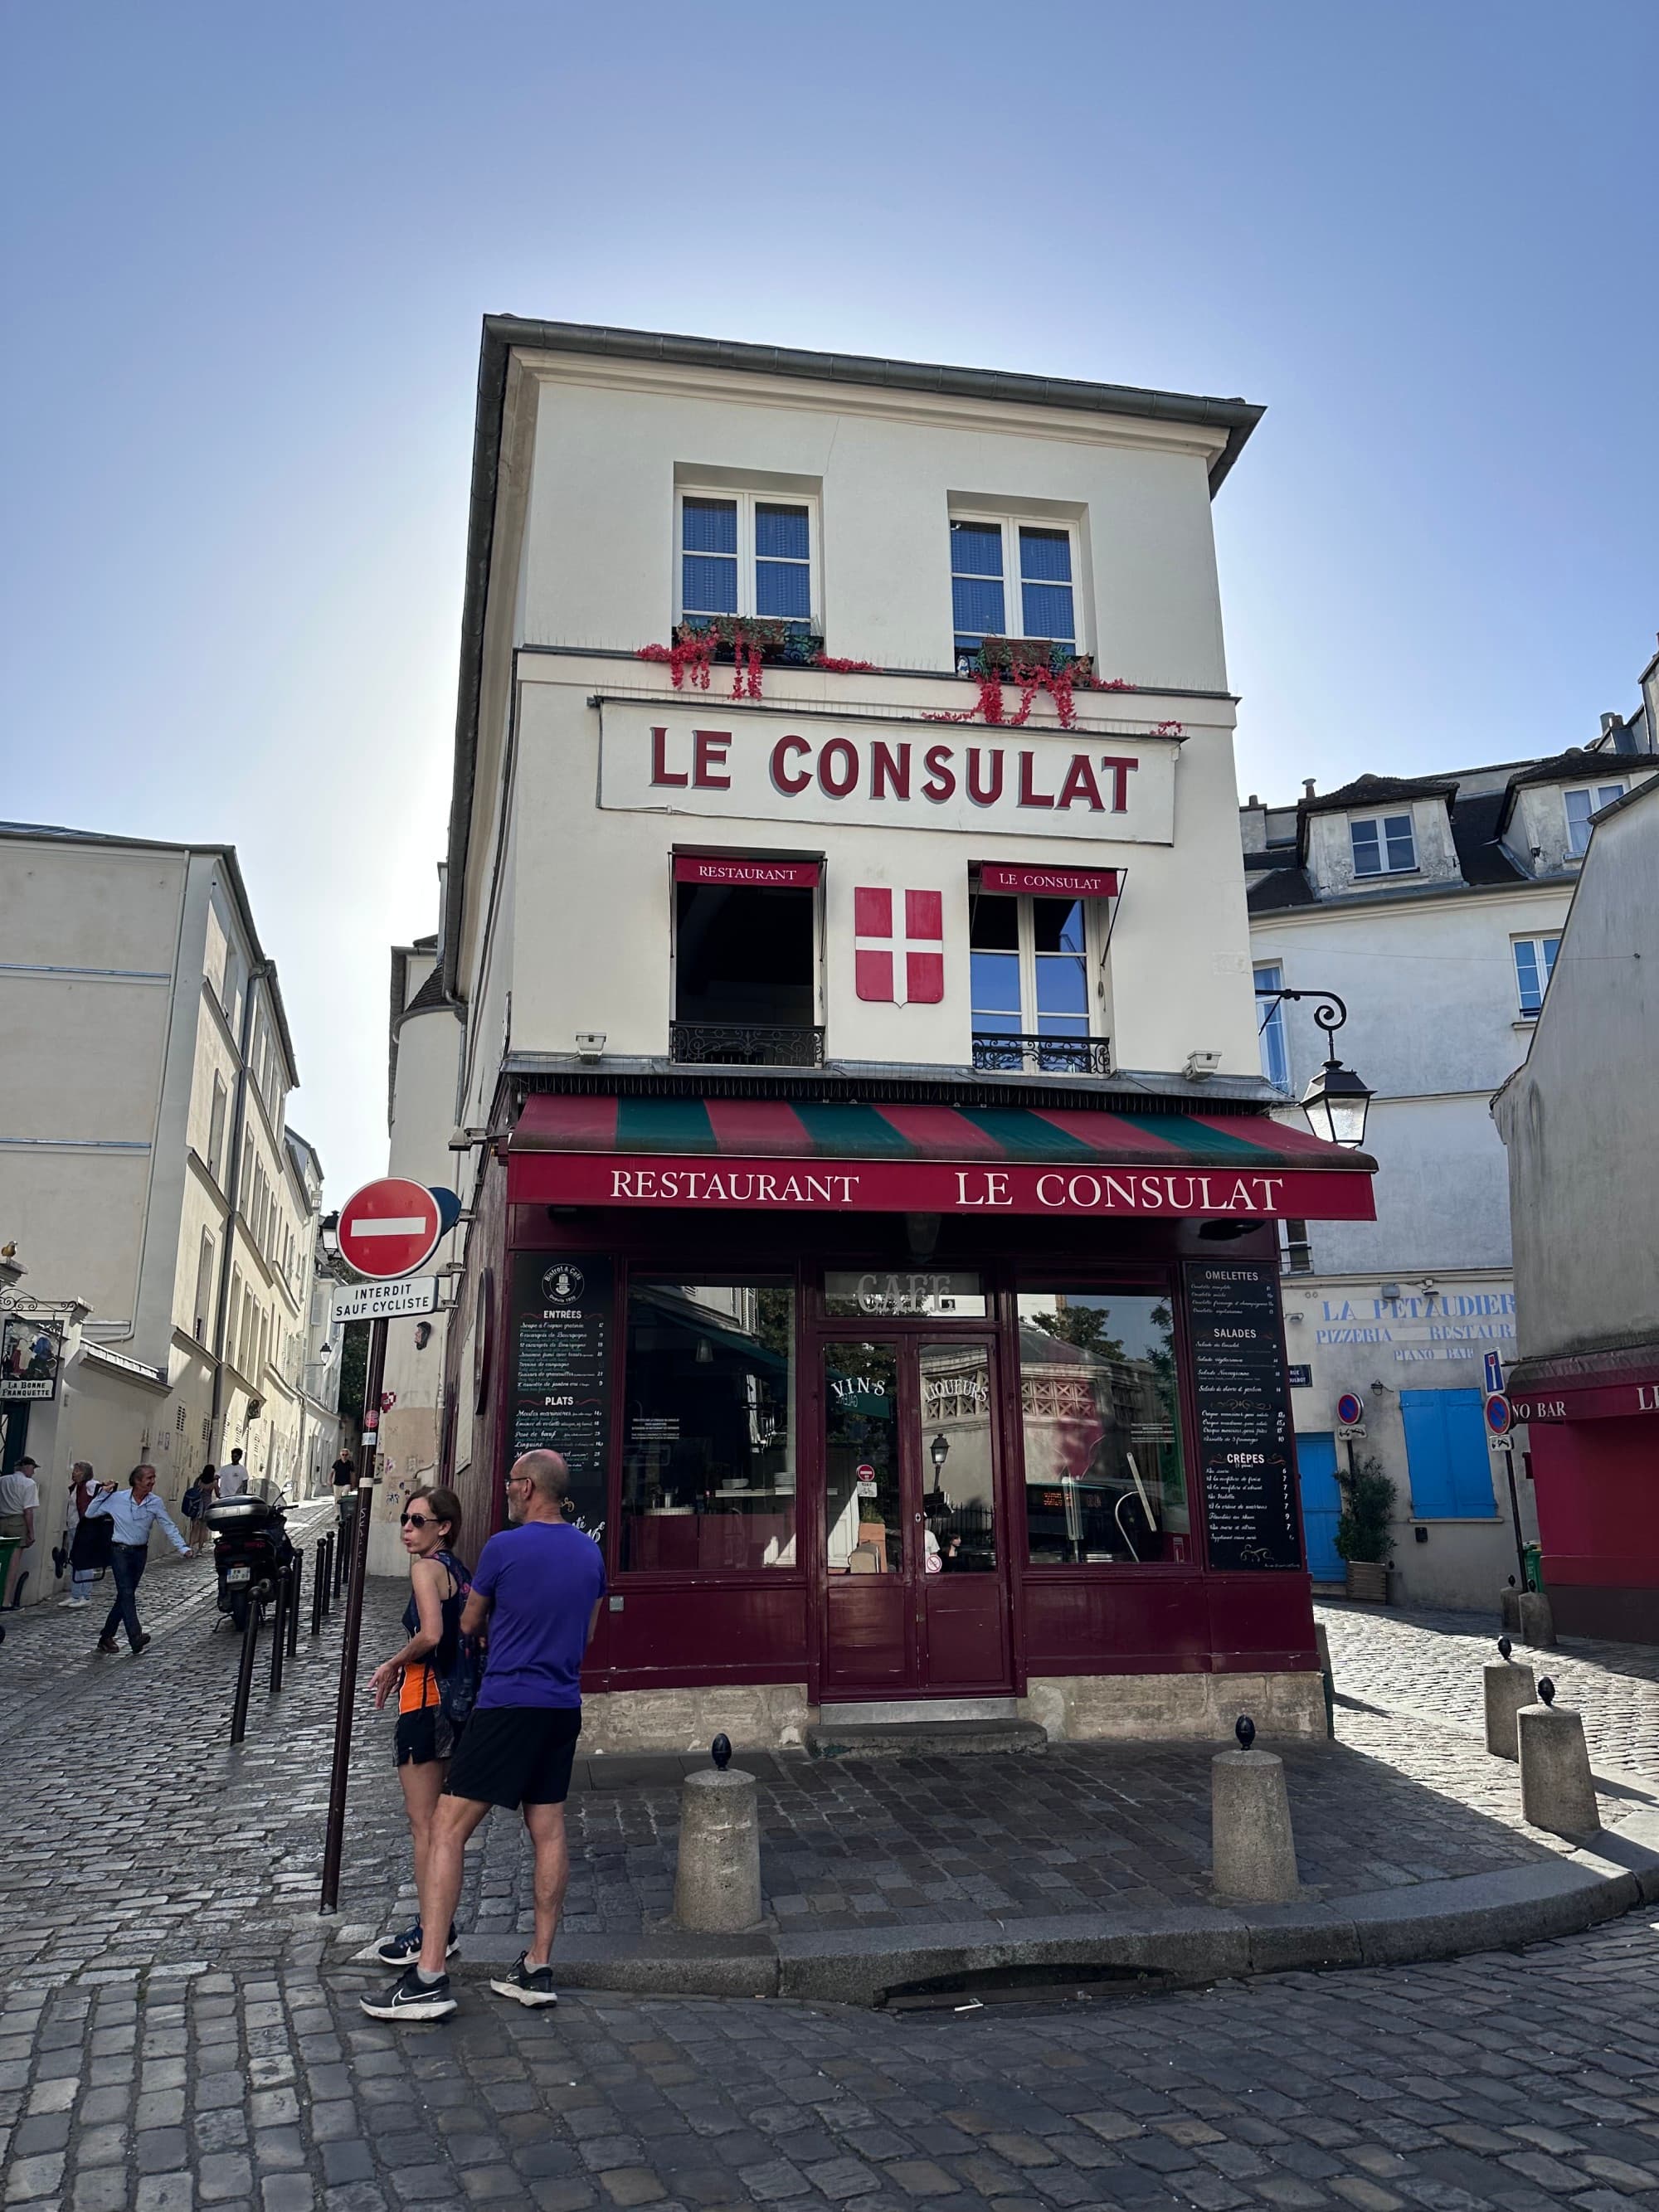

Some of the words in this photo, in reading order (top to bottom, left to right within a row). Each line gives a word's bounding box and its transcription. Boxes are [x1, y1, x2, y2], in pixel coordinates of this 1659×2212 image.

[649, 726, 732, 790] LE
[769, 734, 1140, 814] CONSULAT
[698, 866, 797, 880] RESTAURANT
[999, 873, 1018, 885] LE
[1024, 875, 1102, 889] CONSULAT
[610, 1170, 860, 1203] RESTAURANT
[954, 1172, 1014, 1206] LE
[1036, 1174, 1284, 1212] CONSULAT
[1205, 1271, 1258, 1281] OMELETTES
[355, 1284, 411, 1300] INTERDIT
[336, 1303, 367, 1316] SAUF
[372, 1296, 429, 1312] CYCLISTE
[1322, 1300, 1357, 1321] LA
[1373, 1294, 1515, 1319] PETAUDIER
[543, 1310, 581, 1319] ENTRÉES
[1214, 1328, 1257, 1339] SALADES
[1316, 1327, 1393, 1344] PIZZERIA
[1428, 1324, 1516, 1340] RESTAUR
[1394, 1348, 1435, 1361] PIANO
[1446, 1348, 1474, 1360] BAR
[2, 1388, 50, 1397] FRANQUETTE
[830, 1377, 886, 1398] VINS
[922, 1378, 989, 1403] LIQUEURS
[545, 1397, 574, 1406] PLATS
[1537, 1401, 1566, 1417] BAR
[1227, 1452, 1264, 1464] CRÊPES
